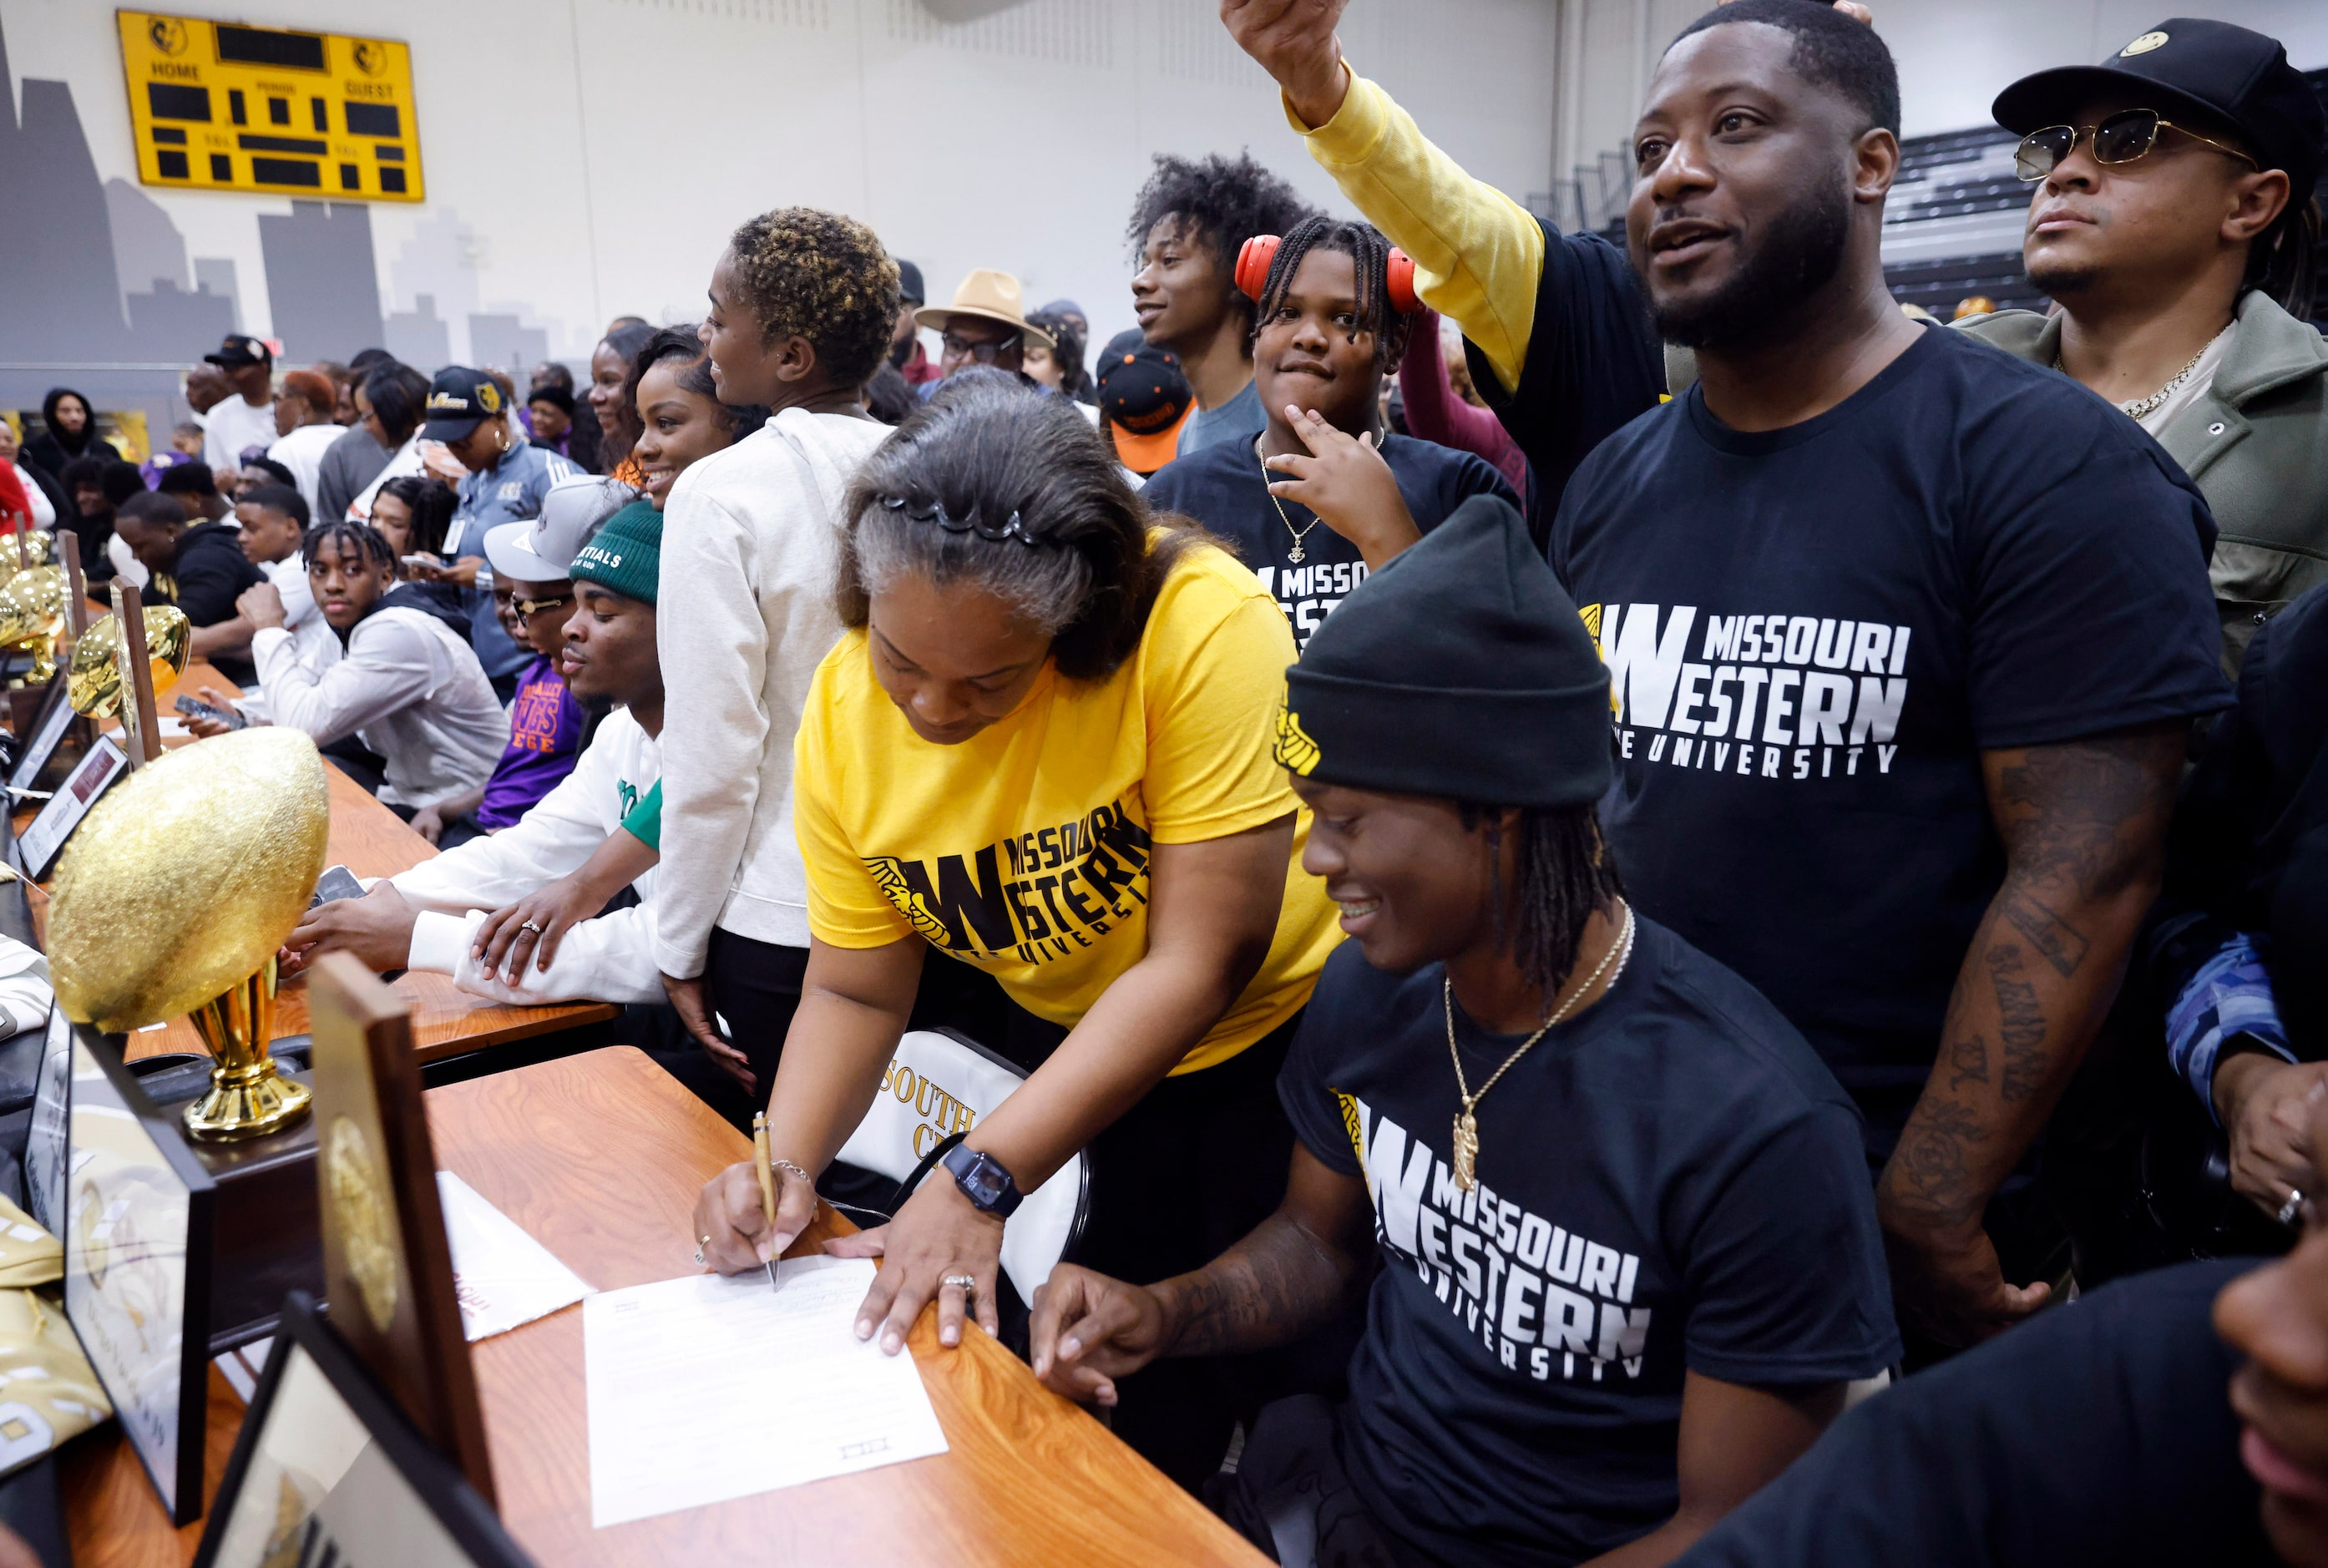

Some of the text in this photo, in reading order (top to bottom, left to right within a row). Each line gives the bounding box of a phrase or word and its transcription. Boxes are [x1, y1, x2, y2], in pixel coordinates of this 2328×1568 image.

[151, 62, 200, 82] HOME
[256, 80, 296, 96] PERIOD
[345, 81, 394, 99] GUEST
[1598, 603, 1909, 746] WESTERN
[1702, 615, 1911, 675] MISSOURI
[1647, 734, 1898, 780] UNIVERSITY
[879, 1058, 976, 1136] SOUTH
[1356, 1096, 1652, 1363] WESTERN
[1432, 1160, 1639, 1304] MISSOURI
